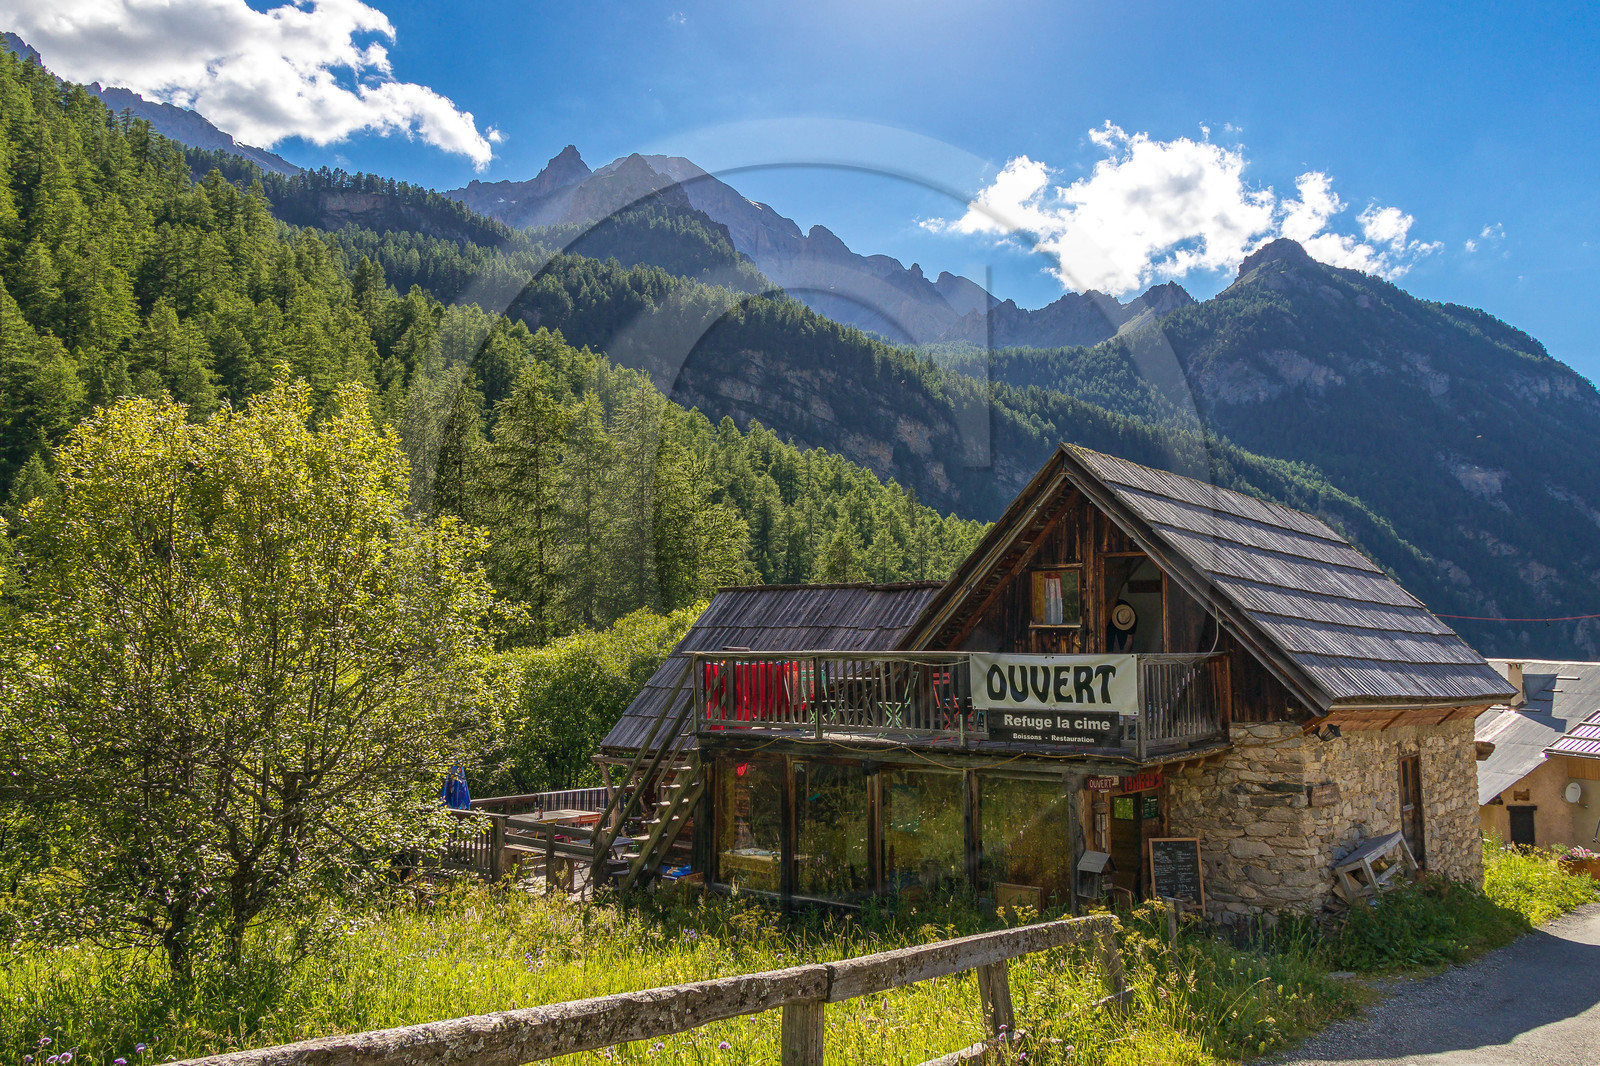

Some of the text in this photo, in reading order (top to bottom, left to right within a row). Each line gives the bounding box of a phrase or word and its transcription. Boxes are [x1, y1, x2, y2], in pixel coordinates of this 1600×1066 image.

[987, 664, 1117, 704] OUVERT
[1004, 714, 1111, 731] Refuge la cime
[1012, 732, 1095, 743] Boissons Restauration
[1089, 778, 1112, 789] OUVERT
